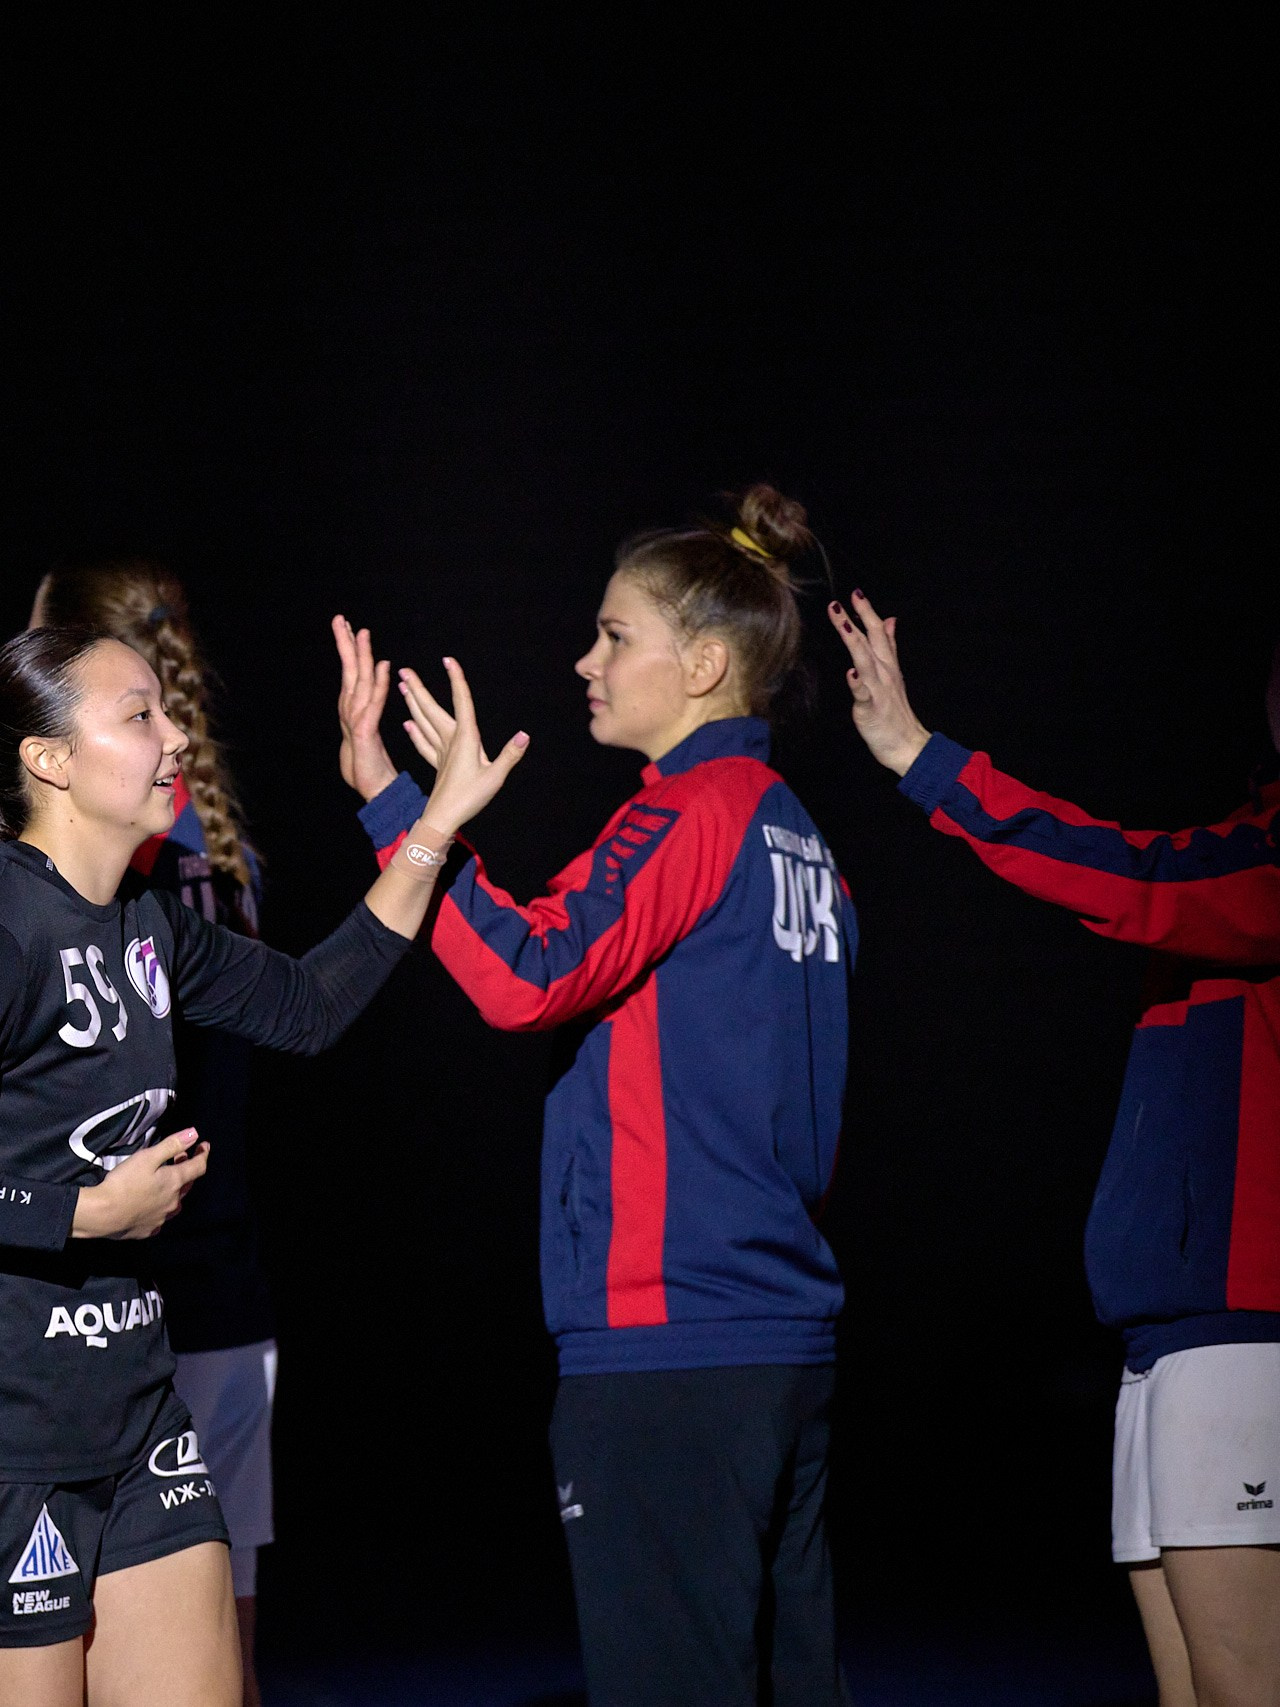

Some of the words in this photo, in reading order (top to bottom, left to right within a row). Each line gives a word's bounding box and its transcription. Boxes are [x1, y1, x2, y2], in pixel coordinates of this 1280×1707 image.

[770, 852, 842, 963] ЦСК
[58, 944, 128, 1048] 59
[1237, 1498, 1274, 1511] erima
[12, 1589, 50, 1605] NEW
[13, 1596, 71, 1615] LEAGUE
